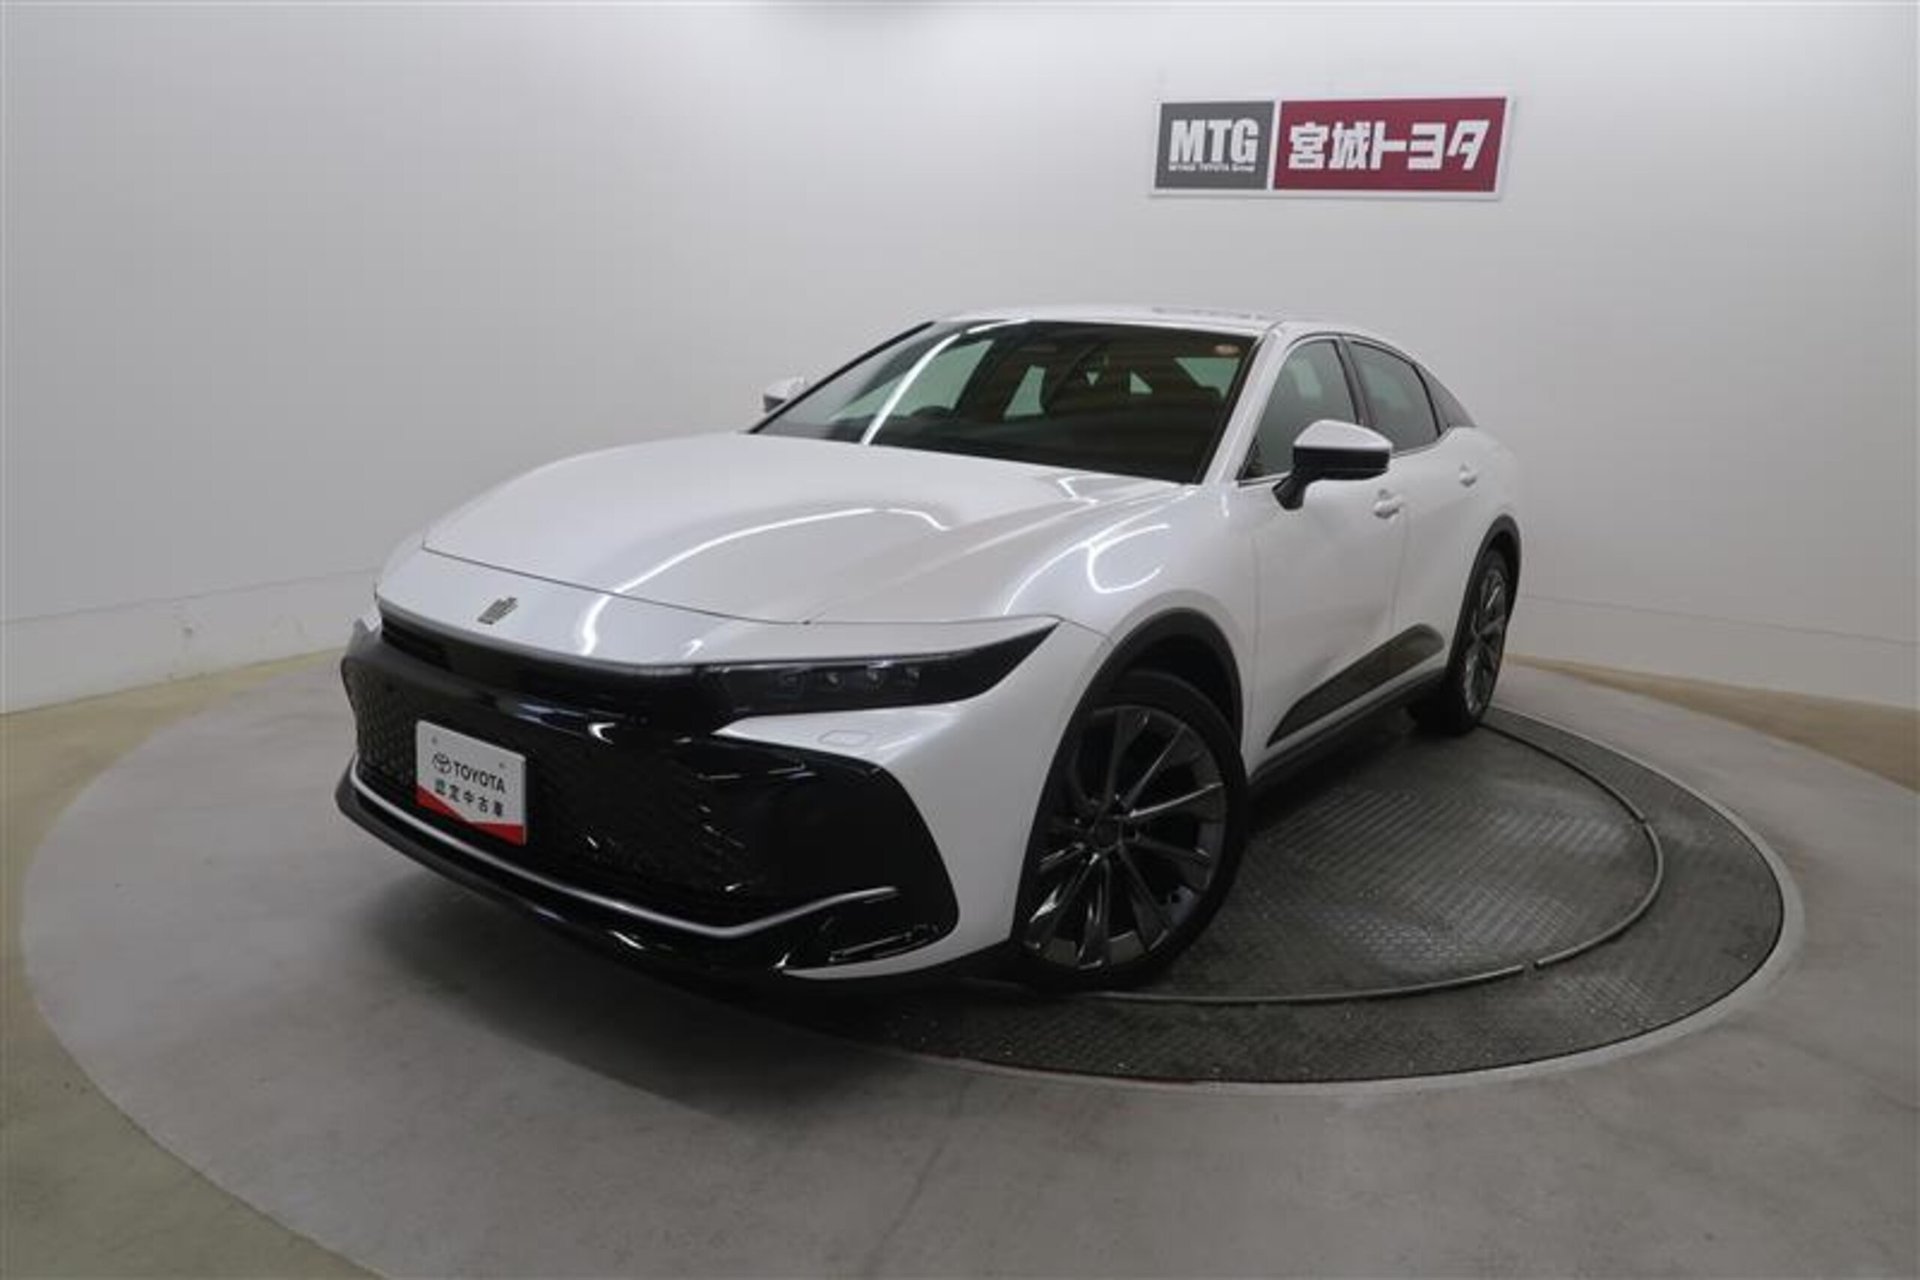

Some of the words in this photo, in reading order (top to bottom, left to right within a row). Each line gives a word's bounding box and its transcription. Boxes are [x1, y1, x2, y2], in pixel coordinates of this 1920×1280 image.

[1169, 118, 1259, 164] MTG
[1287, 119, 1490, 171] 宮城トヨタ
[453, 761, 505, 794] TOYOTA
